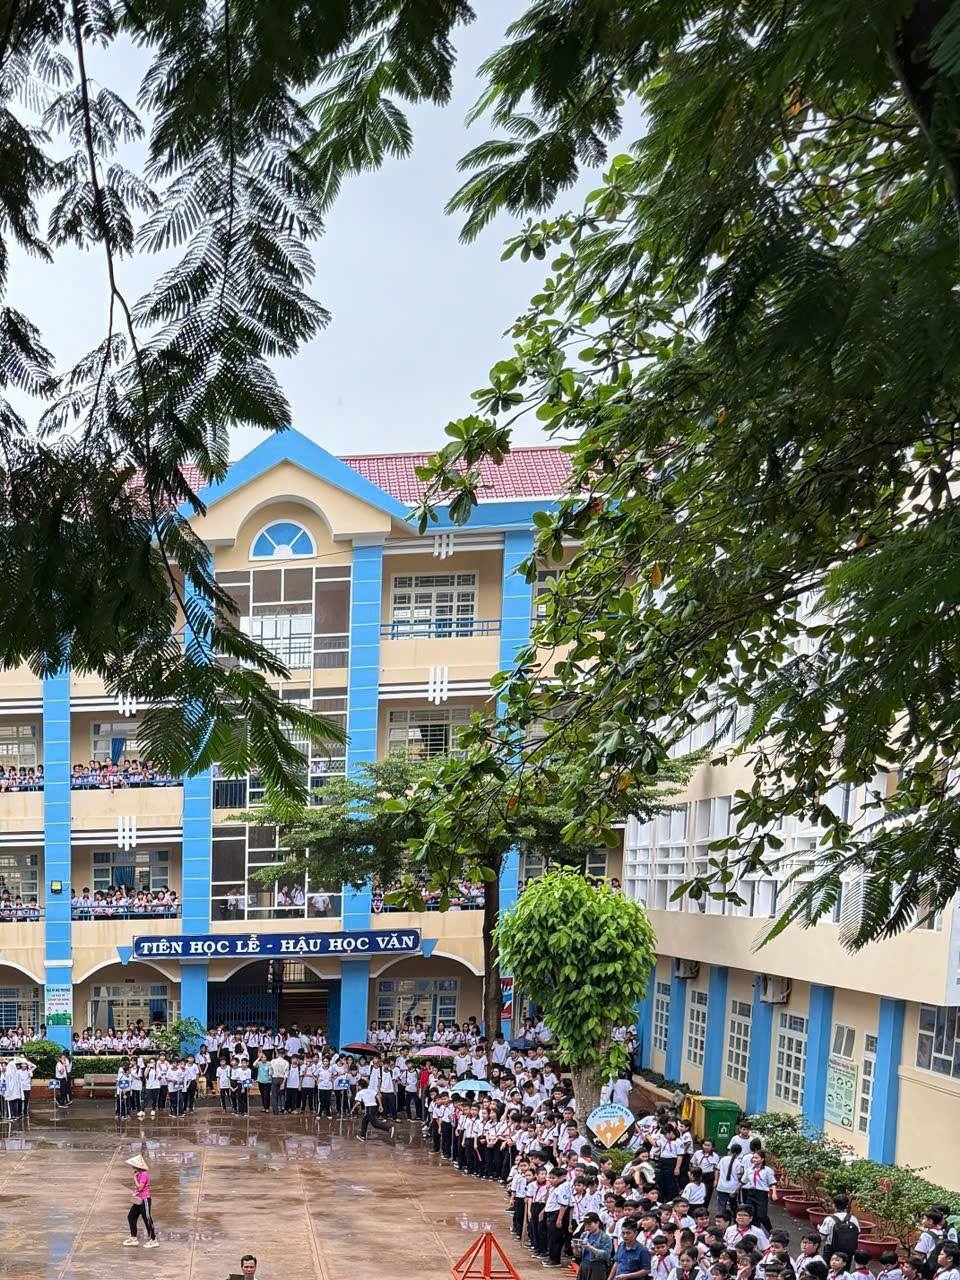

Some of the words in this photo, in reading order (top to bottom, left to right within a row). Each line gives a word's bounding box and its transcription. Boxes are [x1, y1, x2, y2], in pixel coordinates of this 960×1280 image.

[140, 938, 183, 954] TIÊN
[189, 940, 229, 956] HỌC
[235, 934, 260, 953] LỄ
[280, 936, 321, 954] HẬU
[328, 937, 369, 953] HỌC
[376, 933, 414, 949] VĂN
